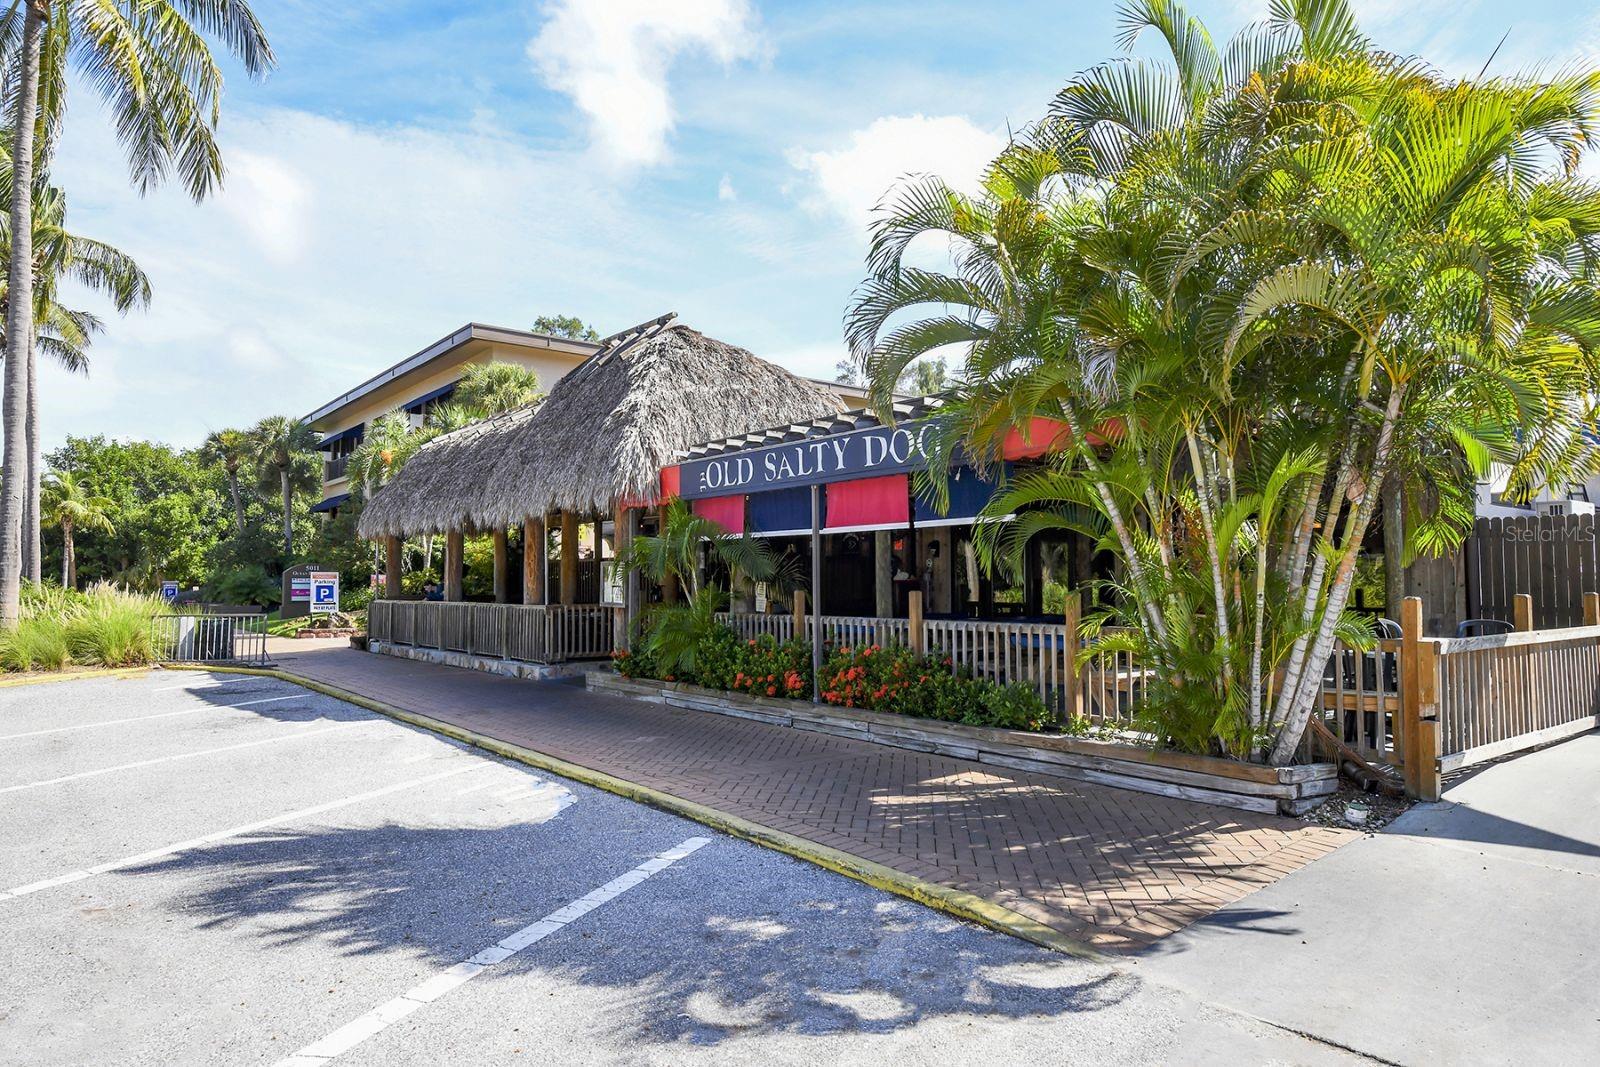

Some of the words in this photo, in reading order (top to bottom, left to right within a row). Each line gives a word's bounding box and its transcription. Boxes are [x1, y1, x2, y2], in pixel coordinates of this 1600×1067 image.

[706, 457, 754, 488] OLD
[764, 437, 851, 482] SALTY
[320, 588, 329, 599] P
